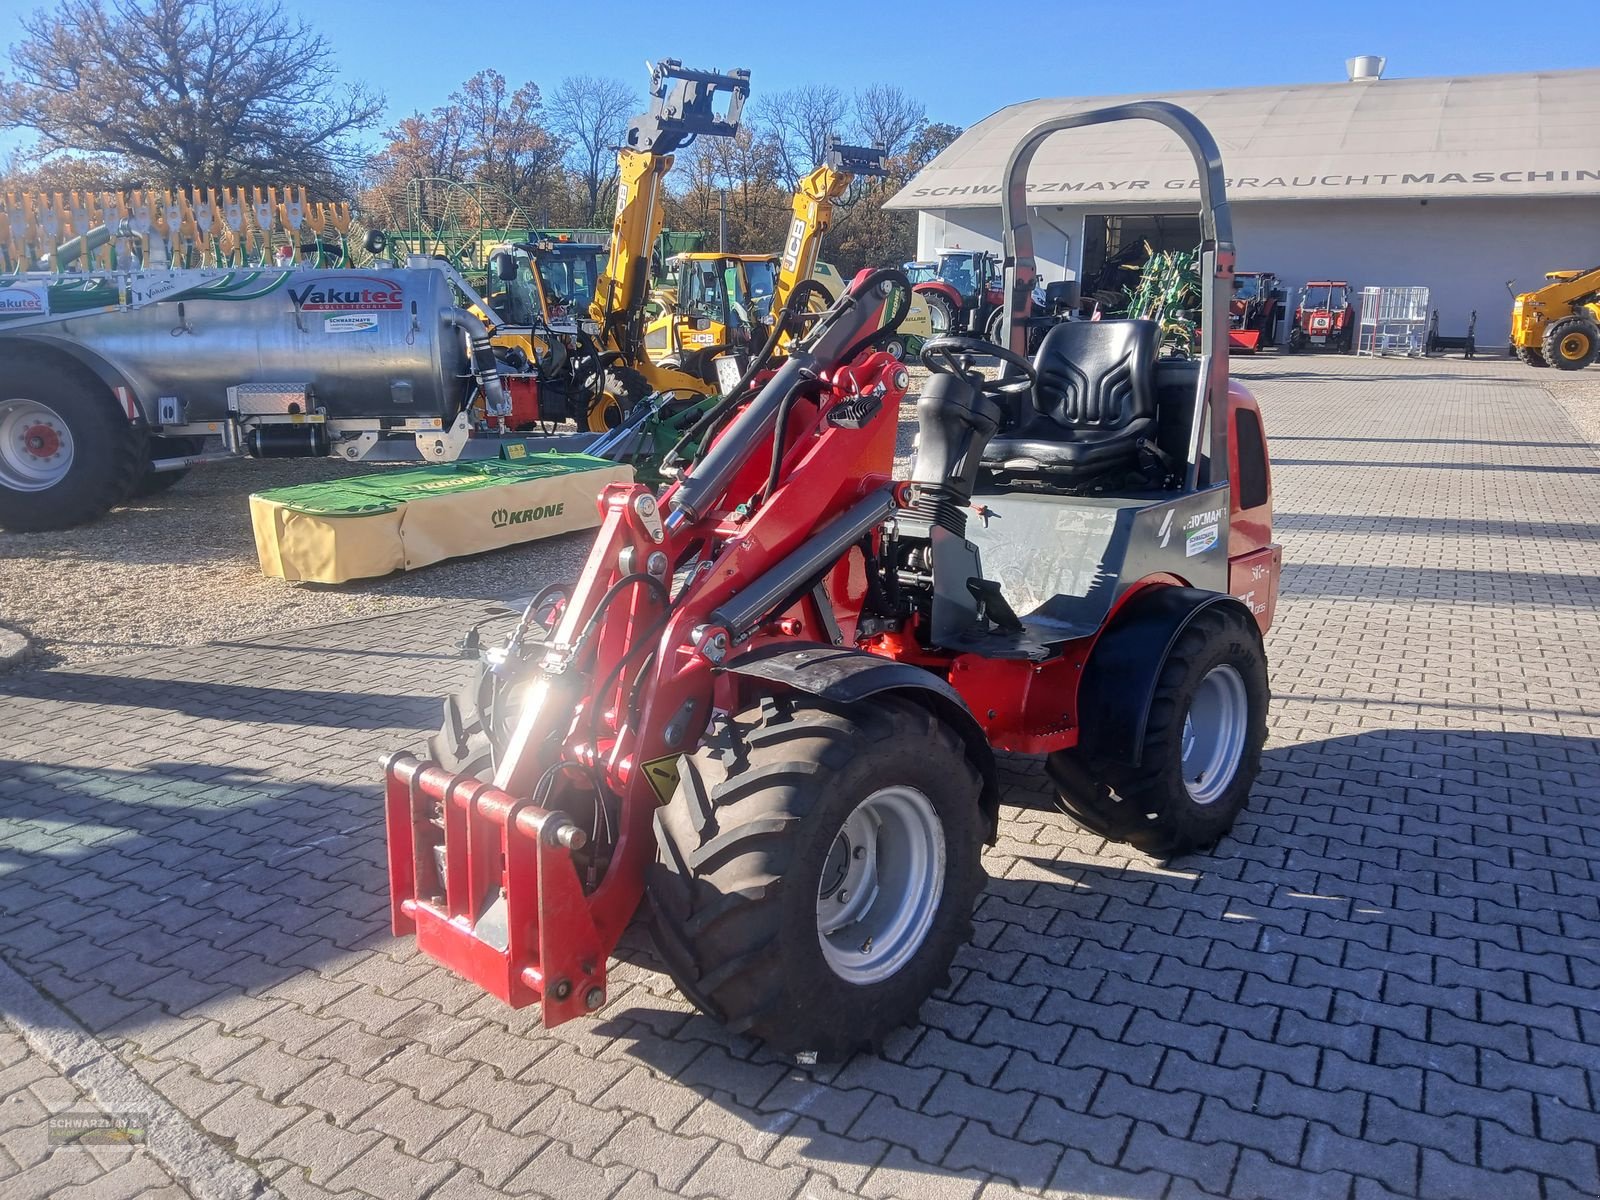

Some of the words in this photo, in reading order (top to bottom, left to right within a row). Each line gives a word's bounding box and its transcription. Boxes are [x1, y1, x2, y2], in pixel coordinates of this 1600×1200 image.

[783, 218, 807, 273] JCB
[0, 299, 41, 308] akutec
[288, 284, 402, 310] Vakutec
[691, 333, 714, 343] JCB
[509, 503, 564, 525] KRONE
